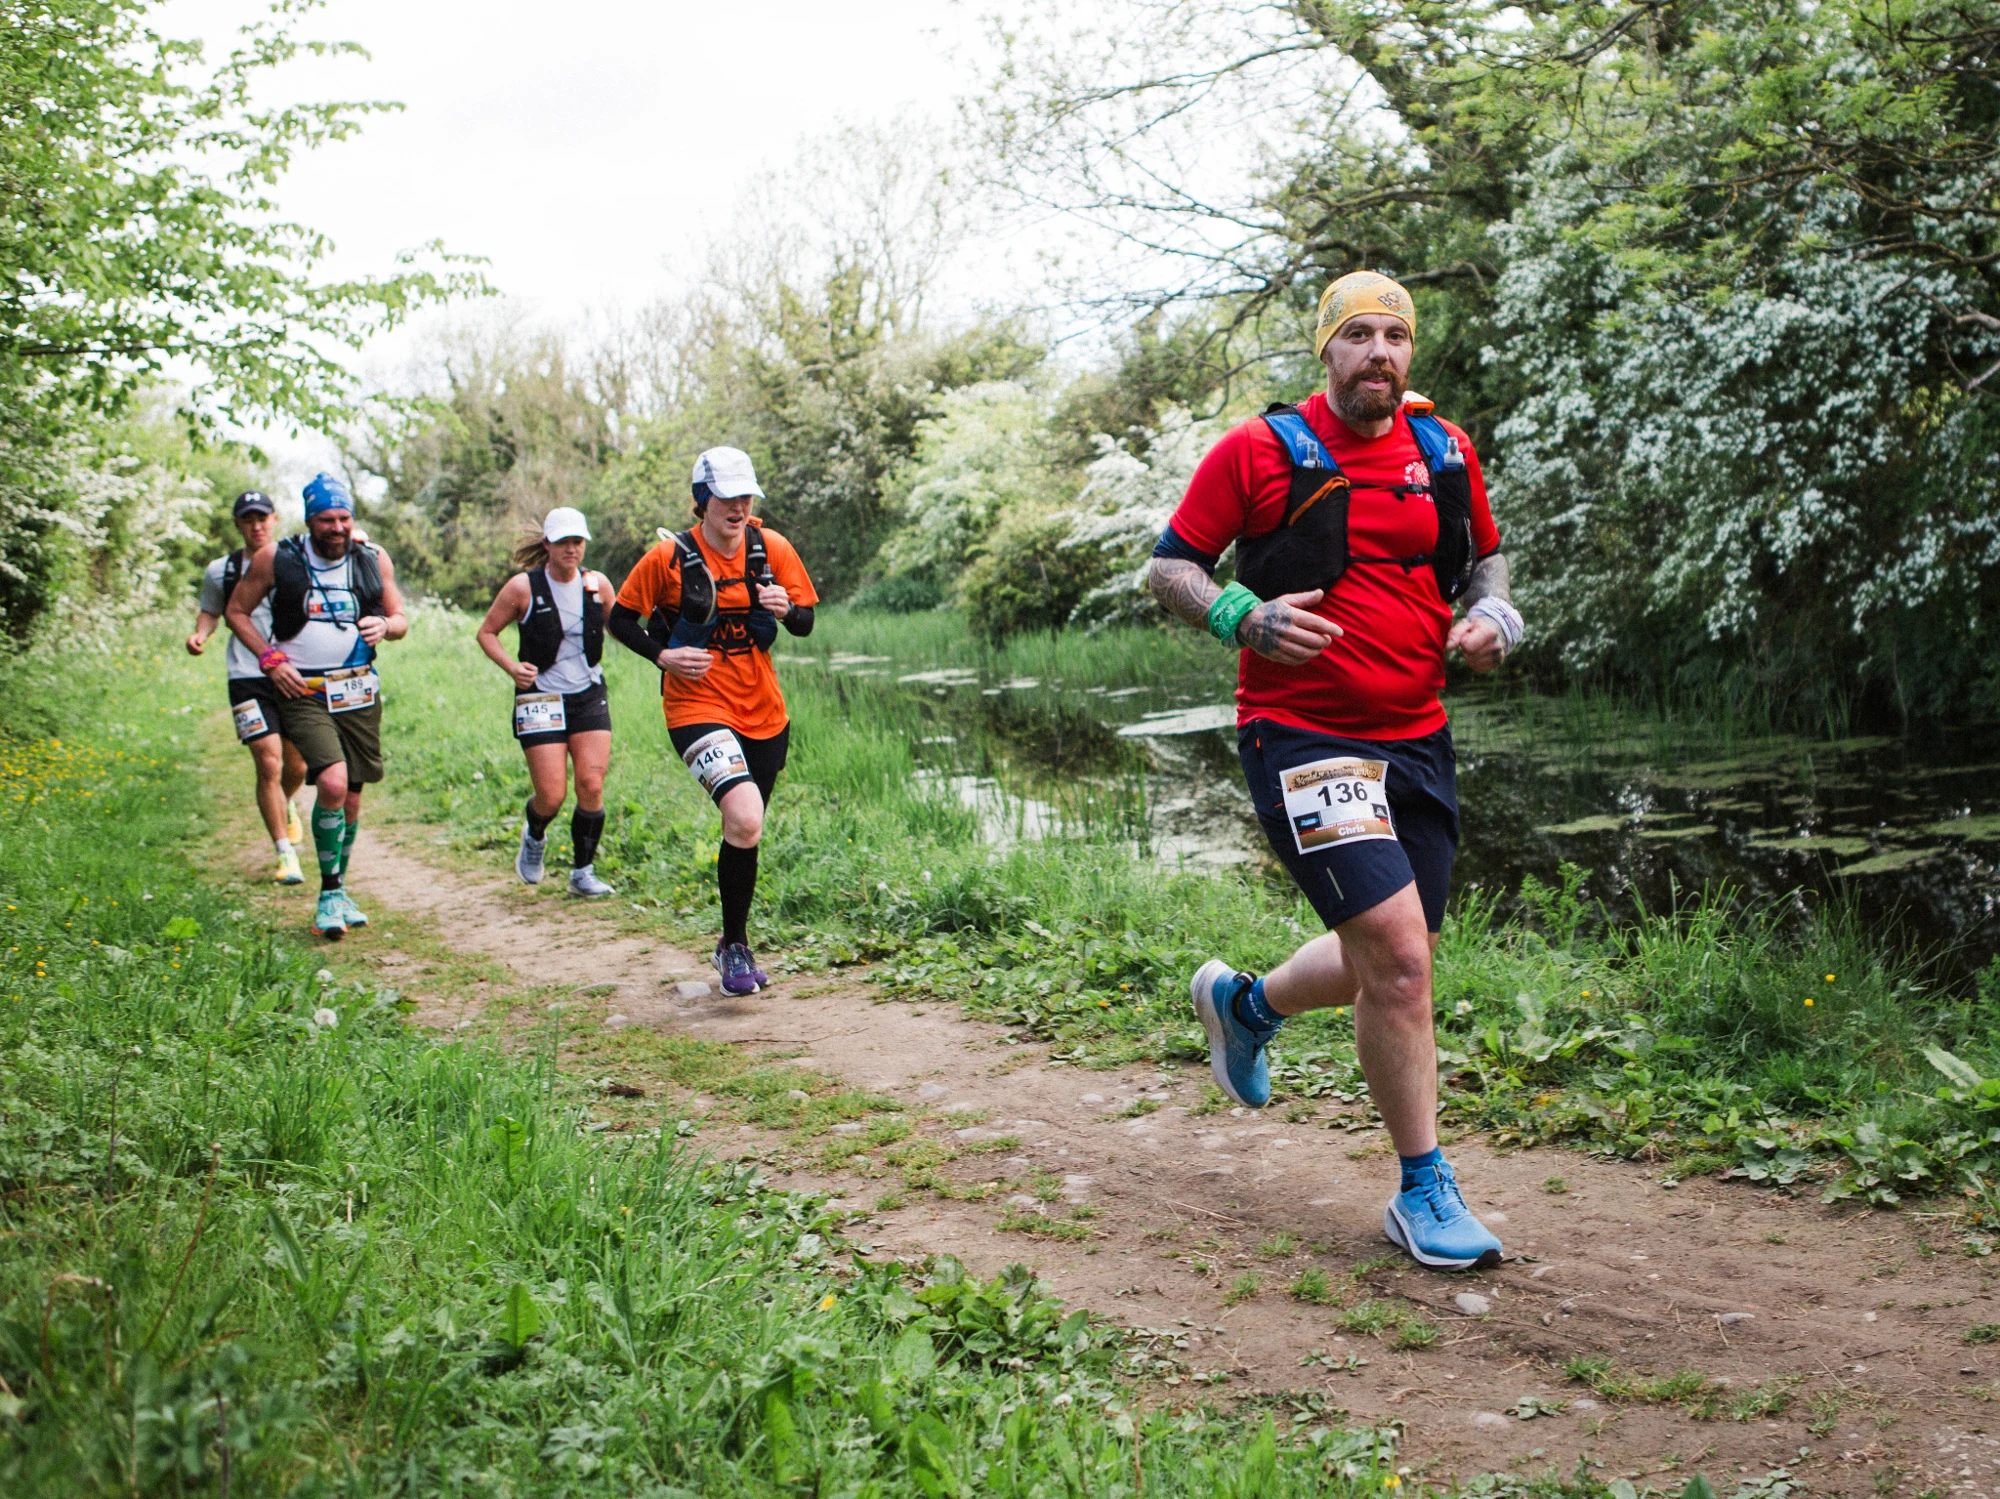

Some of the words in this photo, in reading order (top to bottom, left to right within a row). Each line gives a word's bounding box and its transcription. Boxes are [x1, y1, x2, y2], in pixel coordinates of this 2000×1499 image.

[344, 679, 363, 691] 189
[524, 704, 548, 716] 145
[696, 746, 724, 770] 146
[1317, 781, 1368, 807] 136
[1338, 824, 1366, 837] Chris
